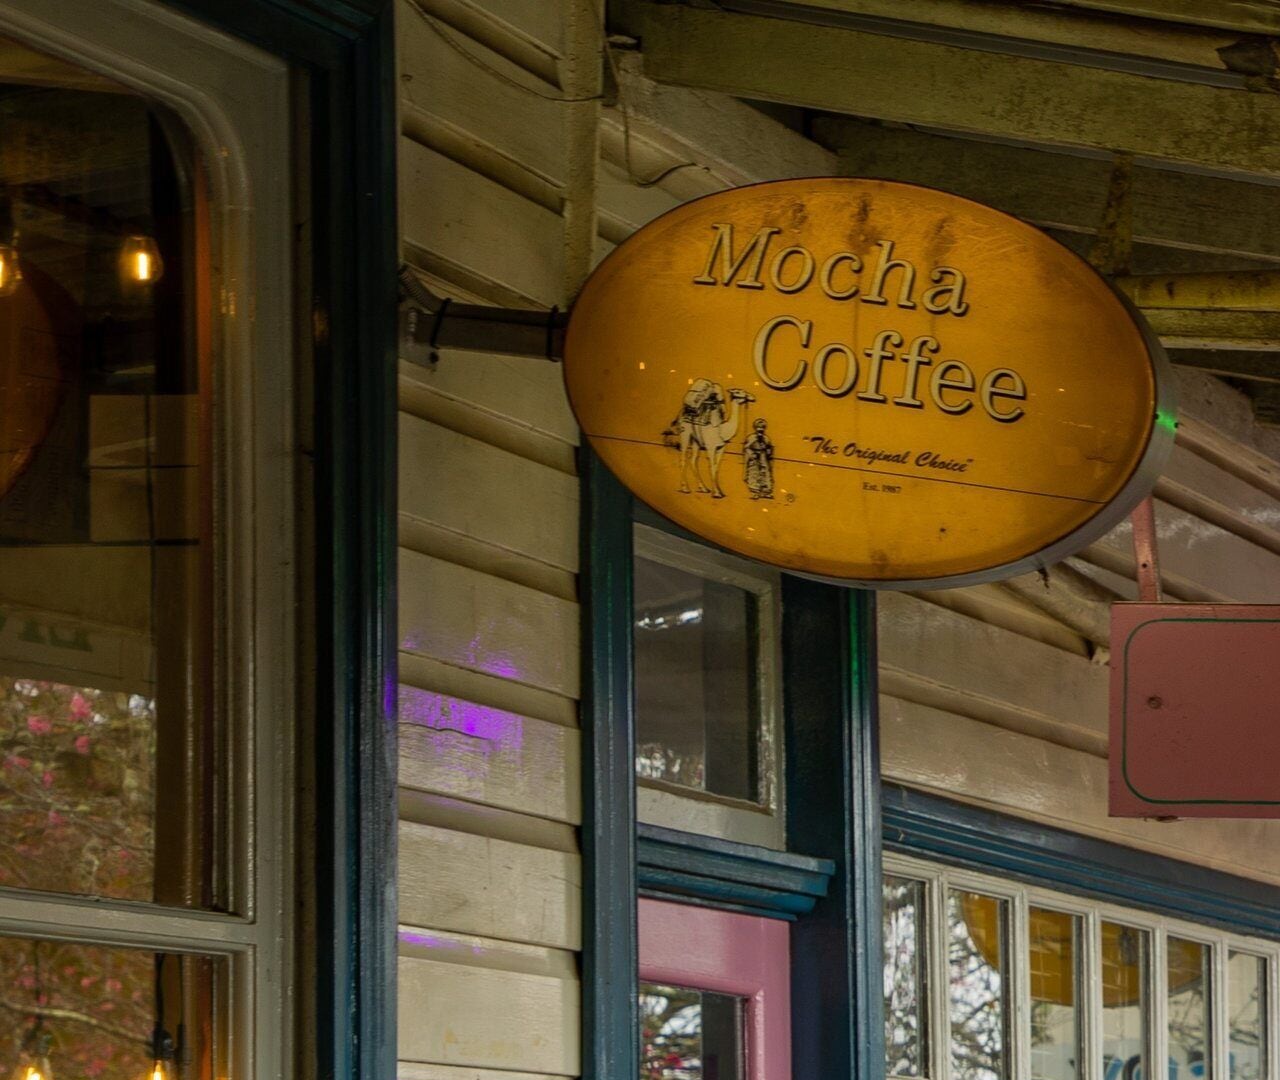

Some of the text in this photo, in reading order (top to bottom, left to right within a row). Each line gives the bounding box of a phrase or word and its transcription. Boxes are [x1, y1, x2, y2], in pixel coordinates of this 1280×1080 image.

[694, 222, 970, 317] Mocha
[753, 314, 1028, 422] Coffee
[843, 442, 909, 466] Original
